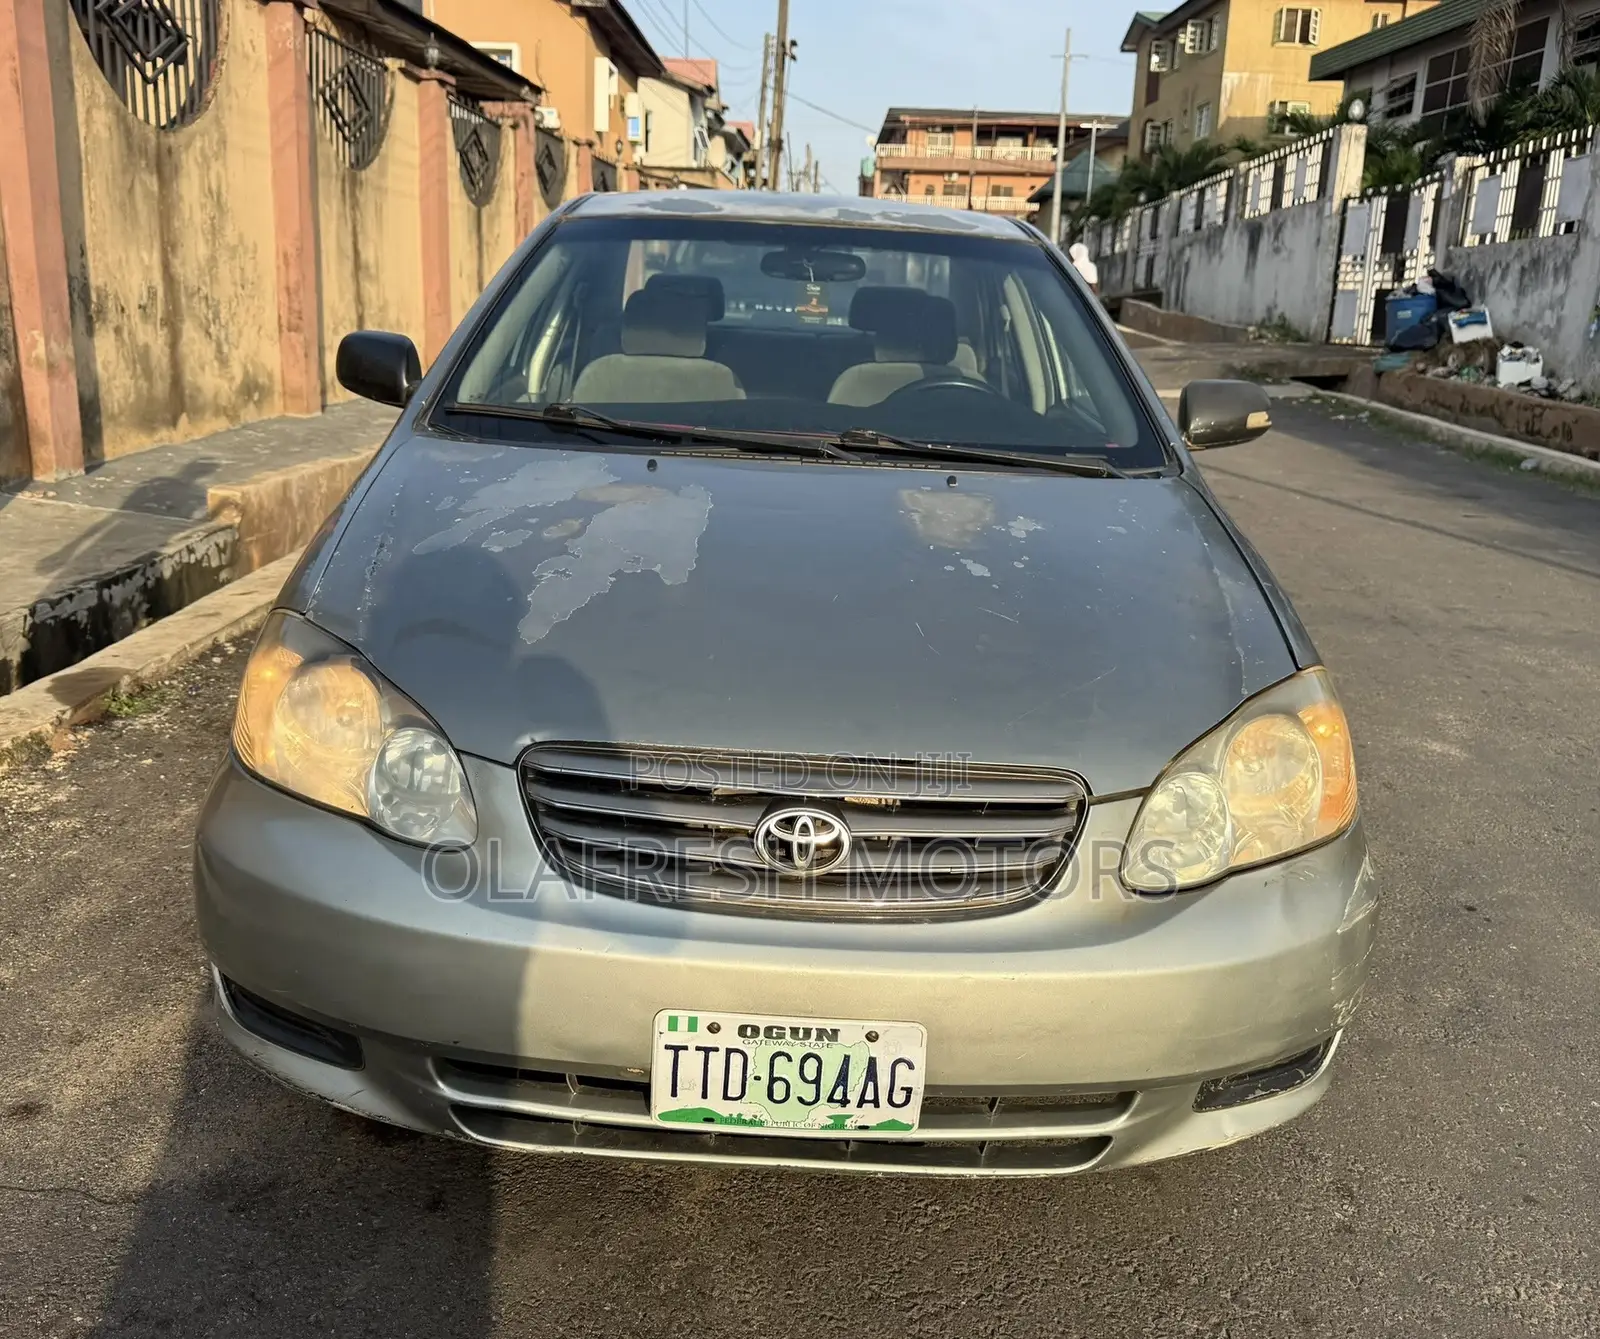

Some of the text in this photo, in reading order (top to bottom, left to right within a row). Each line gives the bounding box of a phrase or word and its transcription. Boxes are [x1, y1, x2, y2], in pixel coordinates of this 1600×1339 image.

[737, 1024, 841, 1042] OGUN
[799, 1041, 834, 1049] STATE
[719, 1115, 761, 1127] FEDERAL
[818, 1122, 854, 1130] NIGERIA
